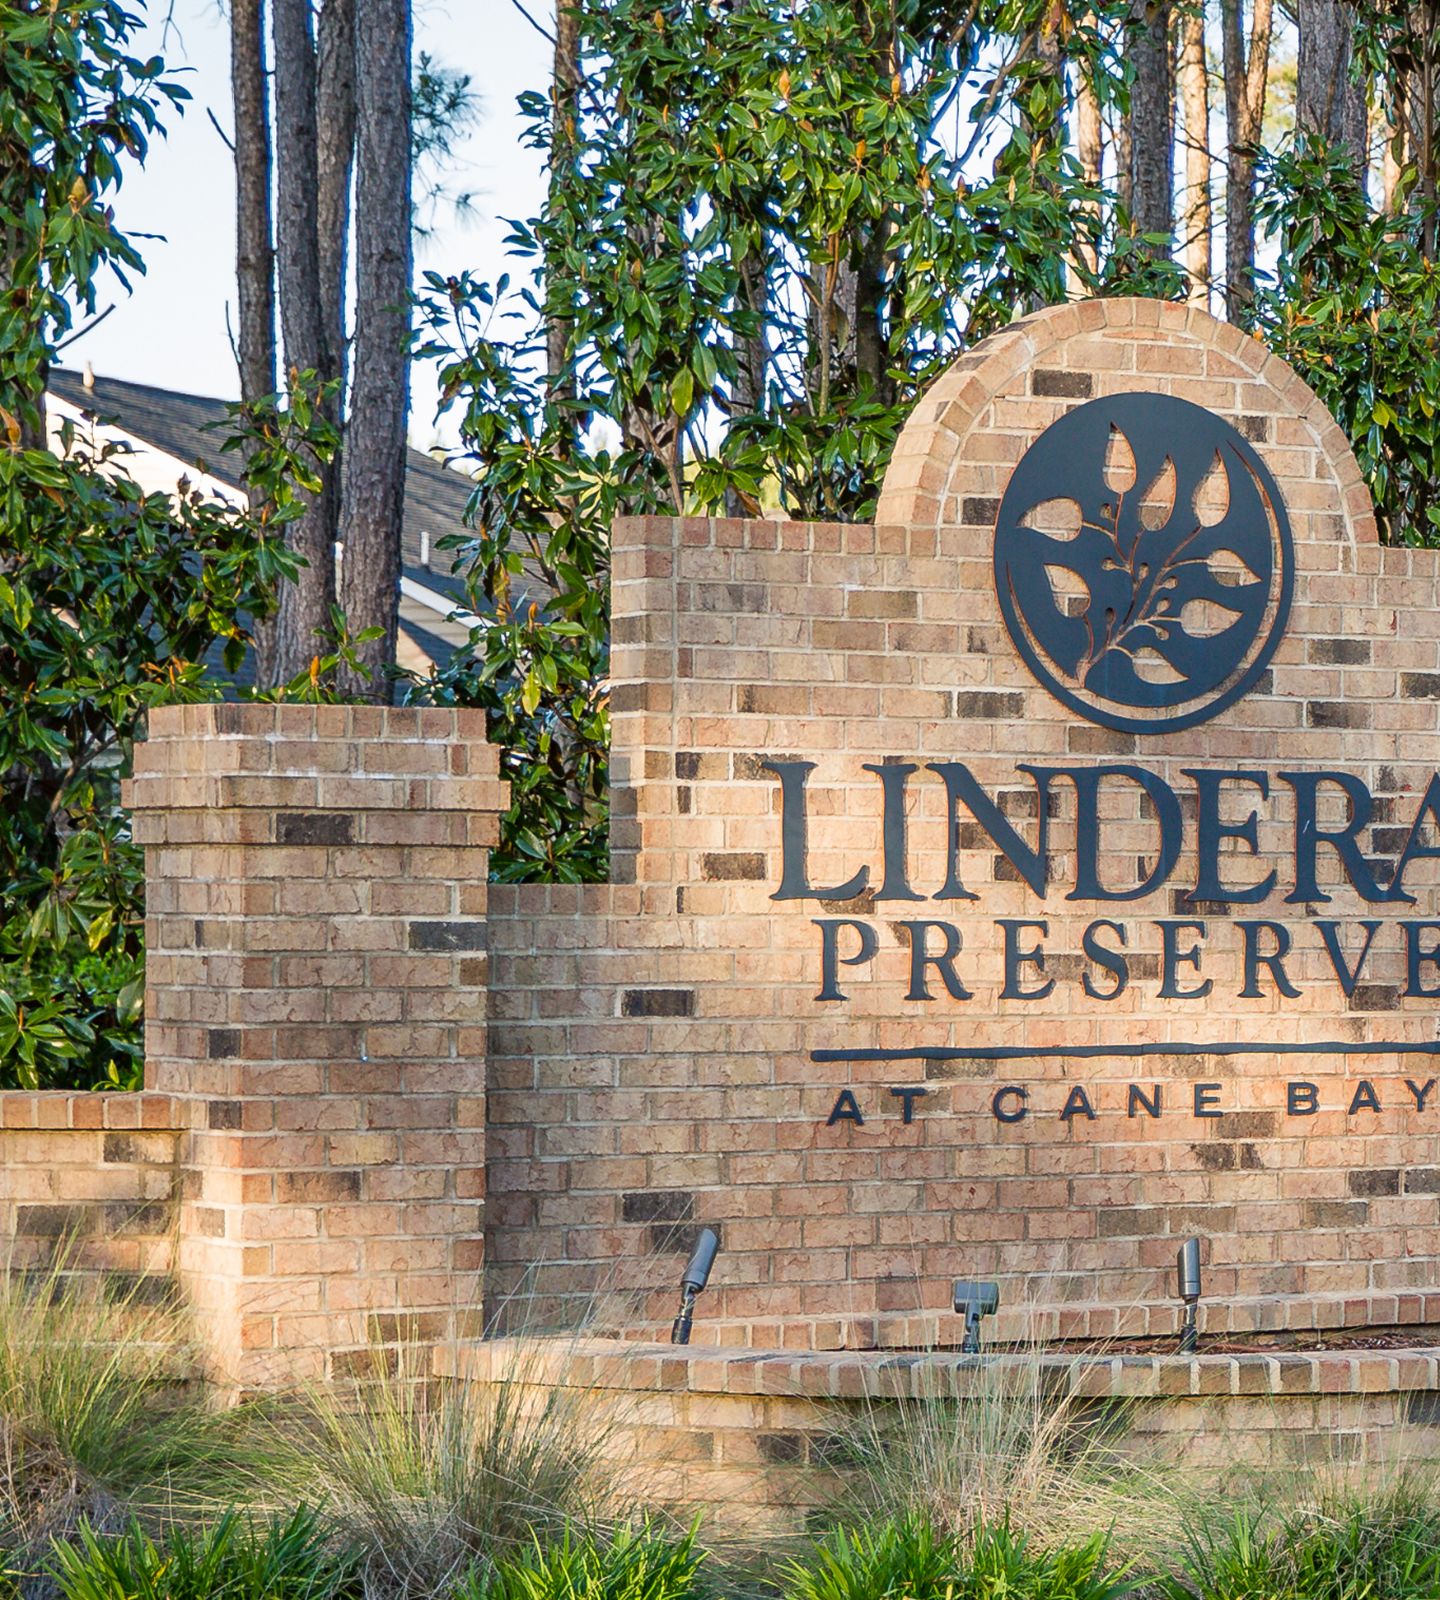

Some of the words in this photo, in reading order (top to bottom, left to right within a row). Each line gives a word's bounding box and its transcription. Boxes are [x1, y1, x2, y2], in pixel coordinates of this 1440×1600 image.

[827, 1086, 927, 1126] AT
[992, 1082, 1224, 1123] CANE
[1286, 1078, 1438, 1116] BAY
